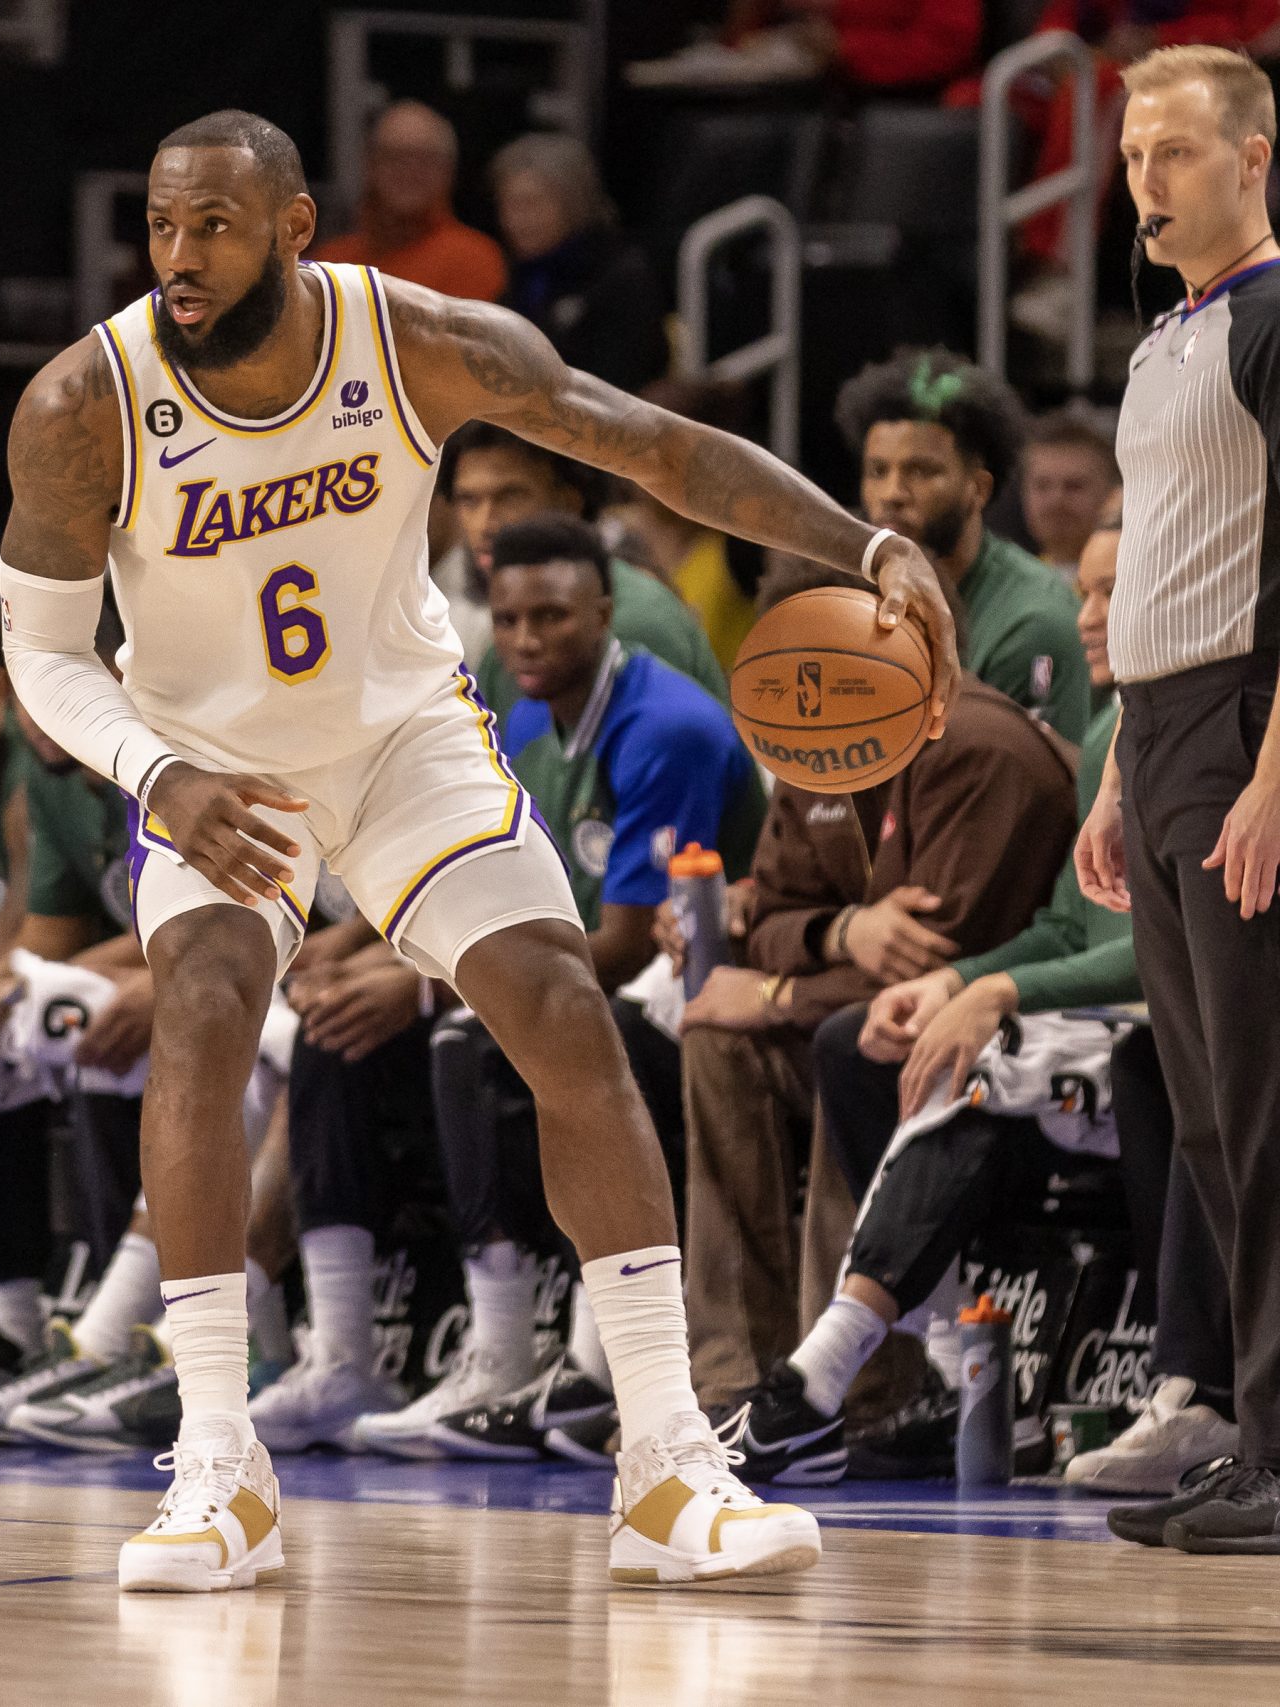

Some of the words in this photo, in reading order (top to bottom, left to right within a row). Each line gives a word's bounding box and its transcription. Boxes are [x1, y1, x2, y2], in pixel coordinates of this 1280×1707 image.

[153, 404, 175, 433] 6
[332, 409, 383, 429] bibigo
[164, 452, 382, 559] LAKERS
[257, 561, 333, 687] 6
[751, 732, 888, 774] Wilson
